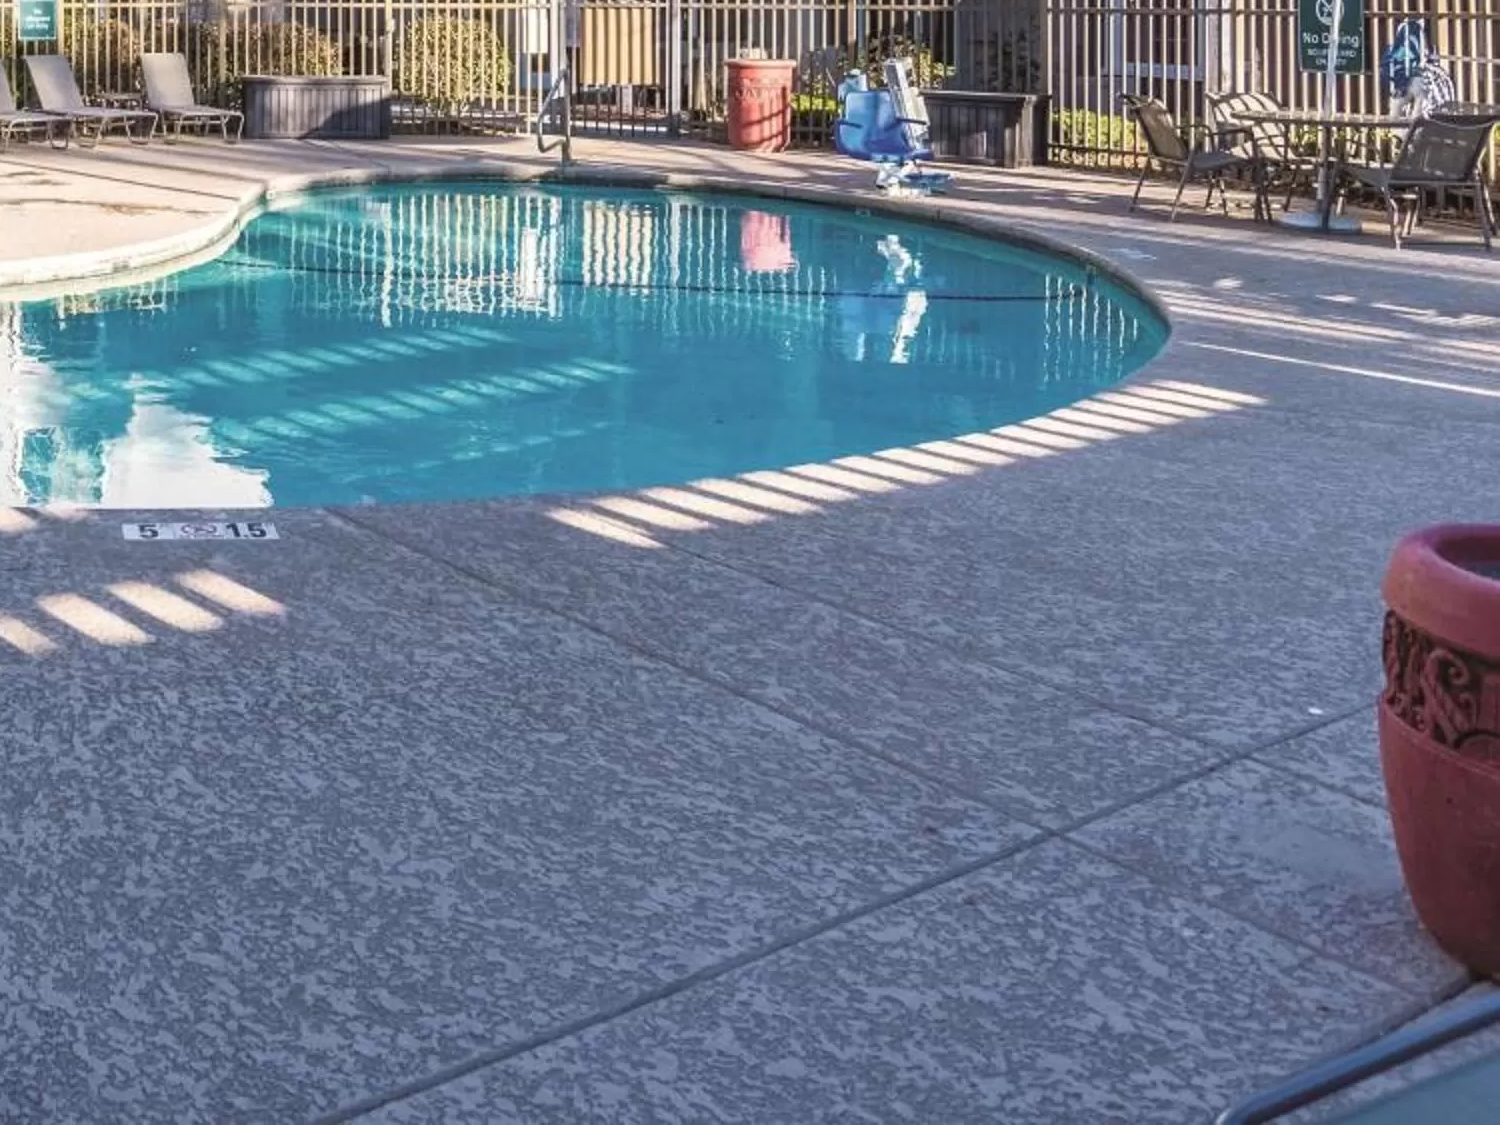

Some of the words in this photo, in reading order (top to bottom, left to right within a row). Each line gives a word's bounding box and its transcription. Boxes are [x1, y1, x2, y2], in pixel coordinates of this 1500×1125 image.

[1303, 32, 1319, 44] No
[1321, 32, 1359, 48] Ding
[139, 524, 159, 538] 5
